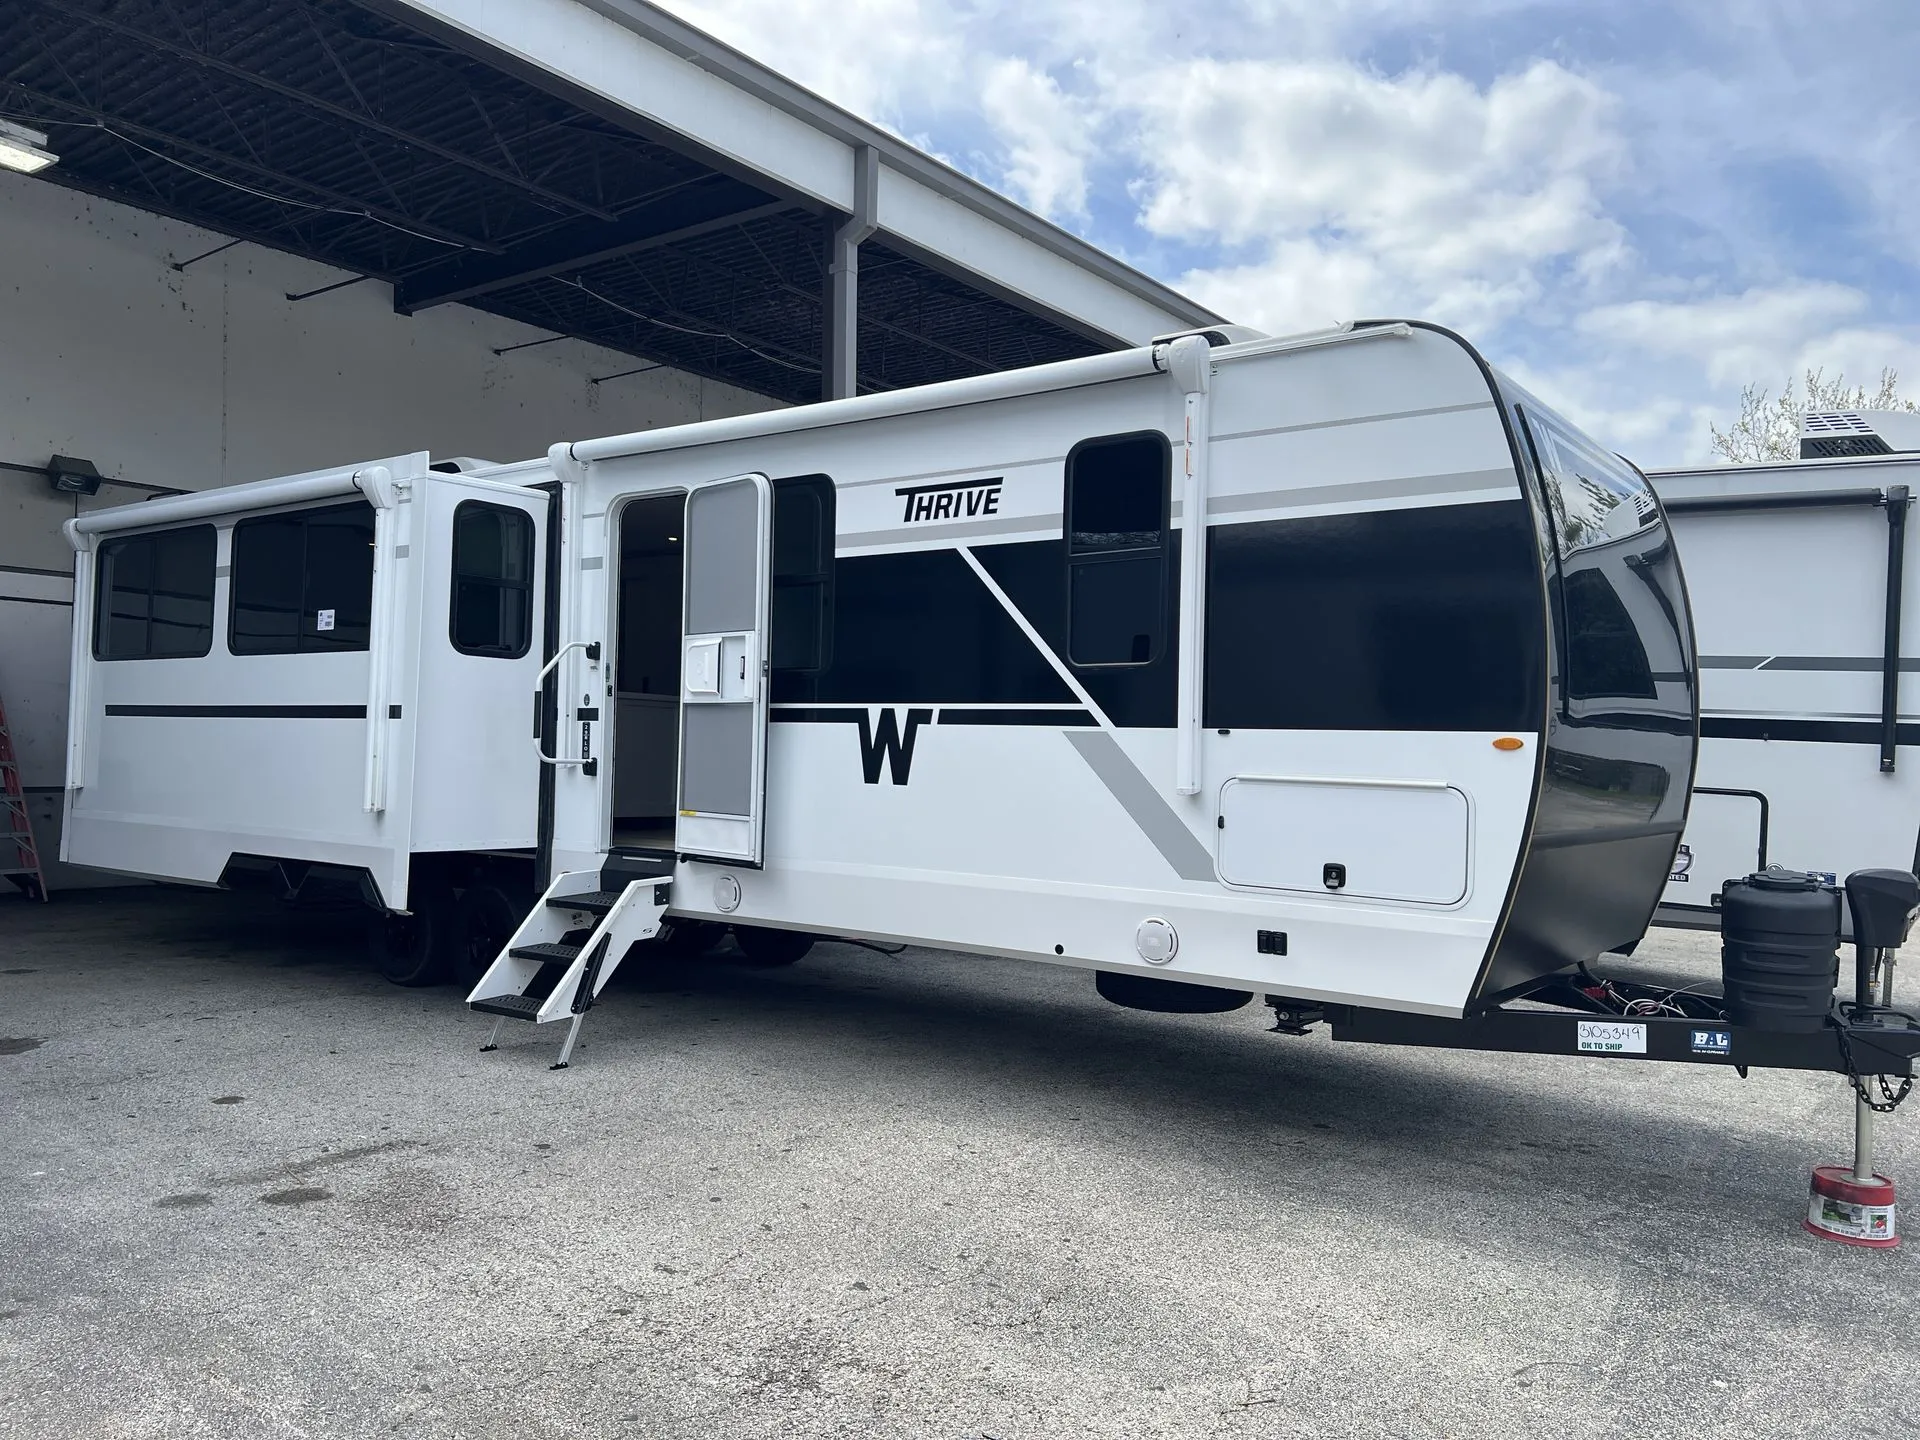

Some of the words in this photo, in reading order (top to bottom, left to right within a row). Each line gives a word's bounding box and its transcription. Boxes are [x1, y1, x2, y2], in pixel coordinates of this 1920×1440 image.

[895, 477, 1004, 522] THRIVE
[858, 708, 933, 786] W
[1580, 1024, 1641, 1040] 3105349
[1581, 1041, 1592, 1050] OK
[1594, 1042, 1603, 1050] TO
[1605, 1042, 1623, 1051] SHIP
